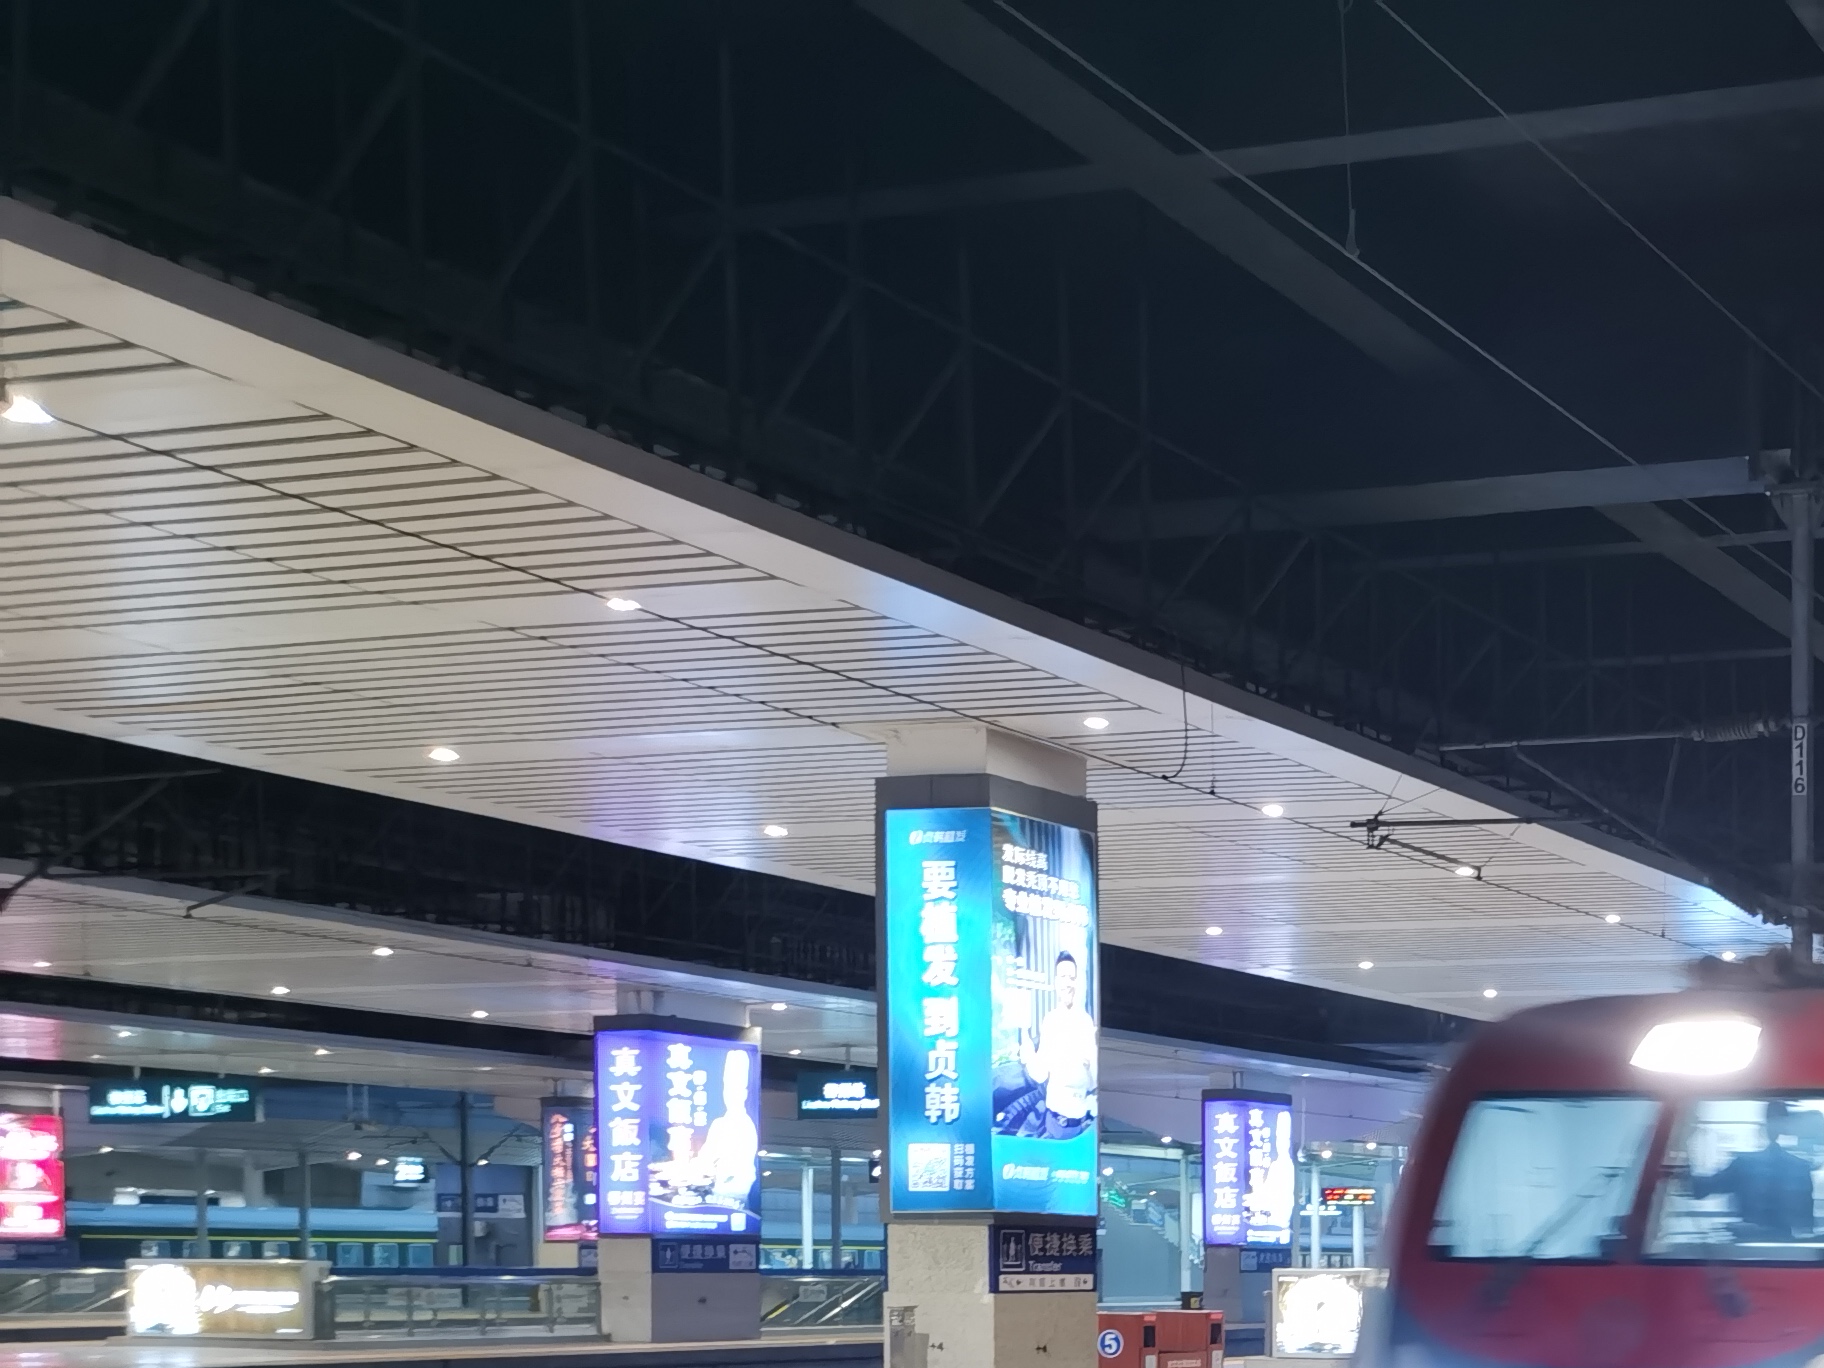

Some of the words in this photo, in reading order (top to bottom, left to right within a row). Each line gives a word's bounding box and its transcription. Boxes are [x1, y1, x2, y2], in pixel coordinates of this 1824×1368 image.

[1794, 725, 1806, 794] D116
[920, 860, 960, 987] 要植发
[923, 996, 961, 1124] 到贞韩
[1028, 1232, 1093, 1257] 便捷换乘
[1104, 1333, 1117, 1354] 5
